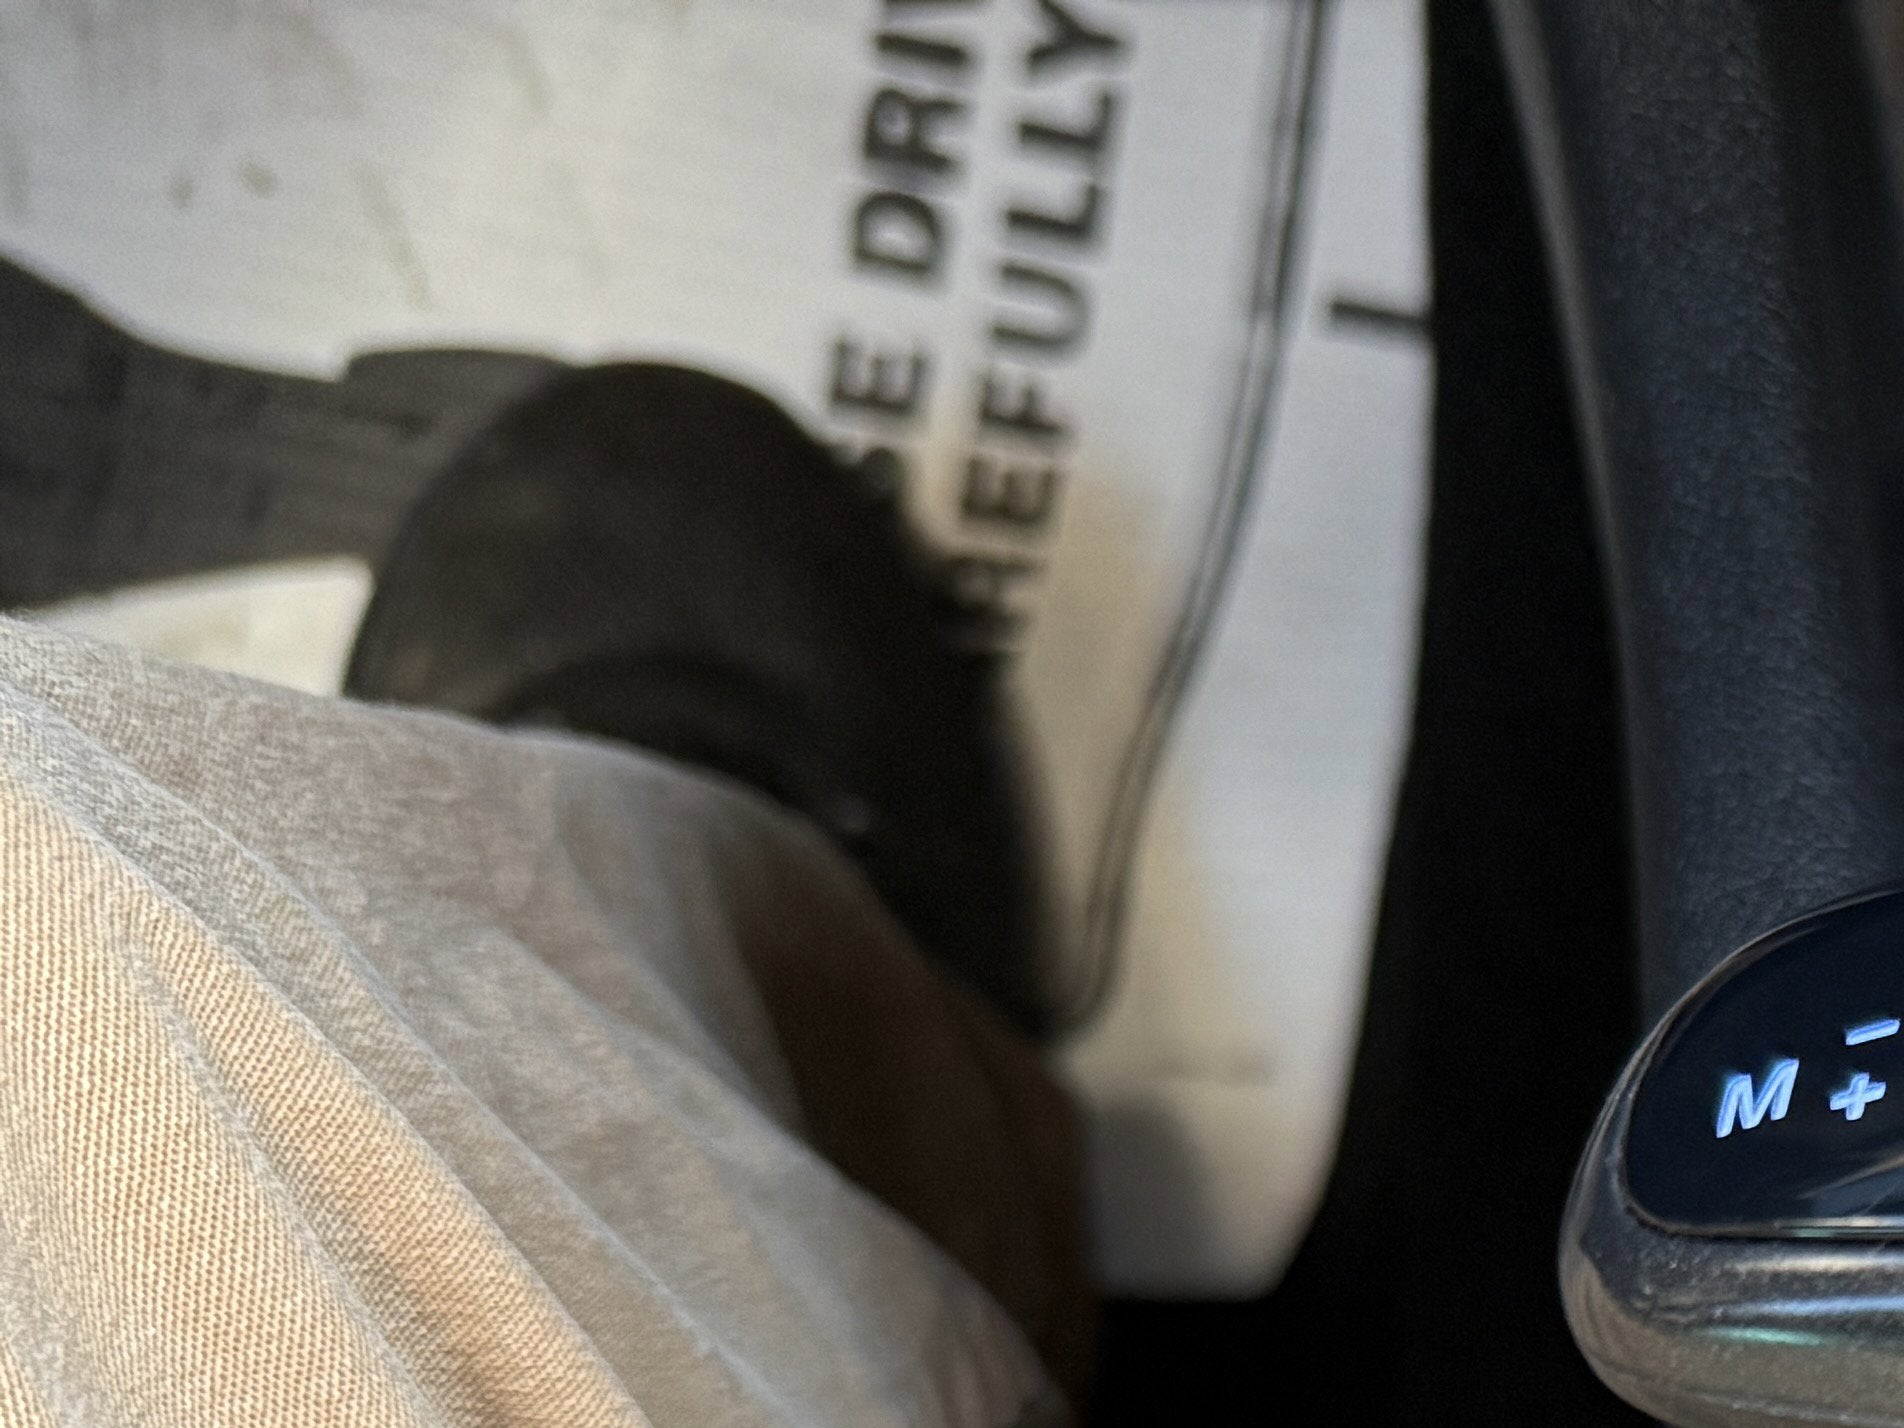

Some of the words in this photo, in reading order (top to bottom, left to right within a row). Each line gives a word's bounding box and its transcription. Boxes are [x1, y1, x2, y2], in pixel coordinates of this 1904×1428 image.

[853, 0, 974, 278] DRI
[938, 0, 1124, 648] REFULLY
[1716, 1058, 1799, 1139] M
